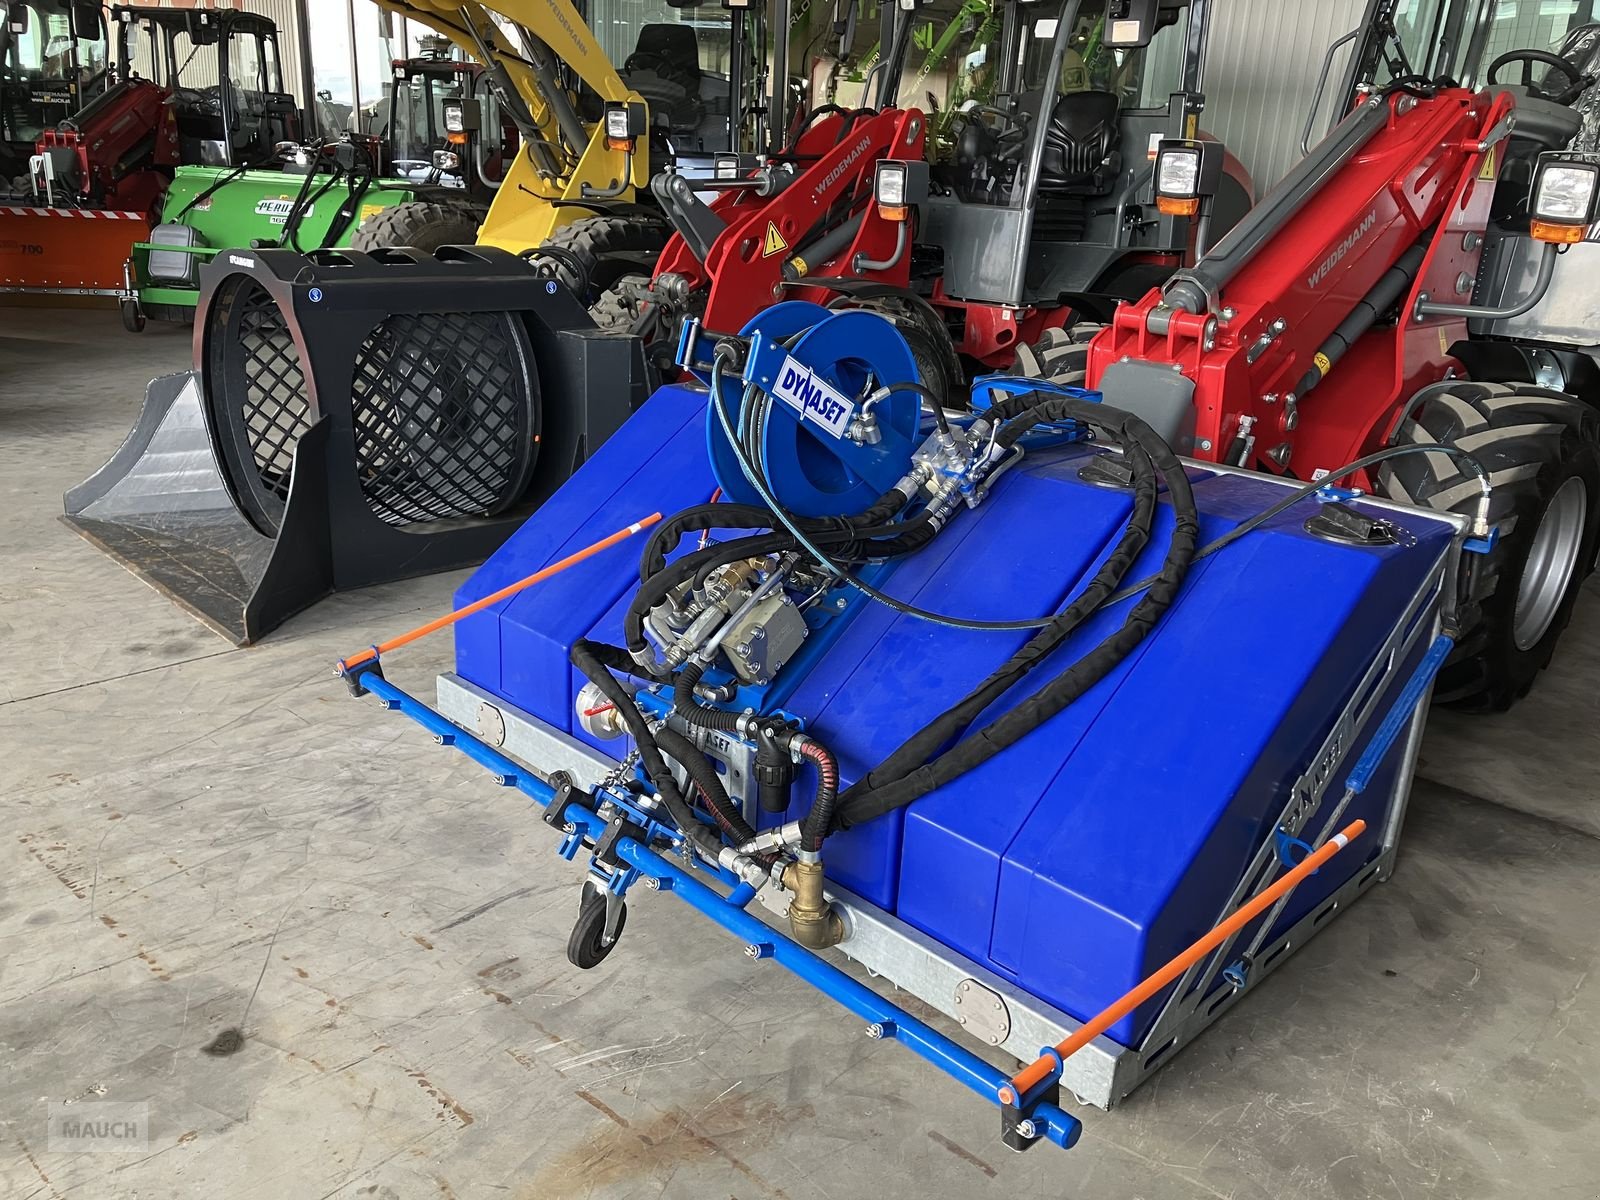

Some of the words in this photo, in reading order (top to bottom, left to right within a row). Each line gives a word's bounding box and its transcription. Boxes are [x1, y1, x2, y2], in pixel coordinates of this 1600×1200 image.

[789, 0, 810, 29] RLO
[815, 136, 871, 194] WEIDEMANN
[258, 201, 309, 214] PERU
[1308, 209, 1376, 288] WEIDEMANN
[781, 367, 847, 425] DYNASET
[706, 731, 730, 752] ASET
